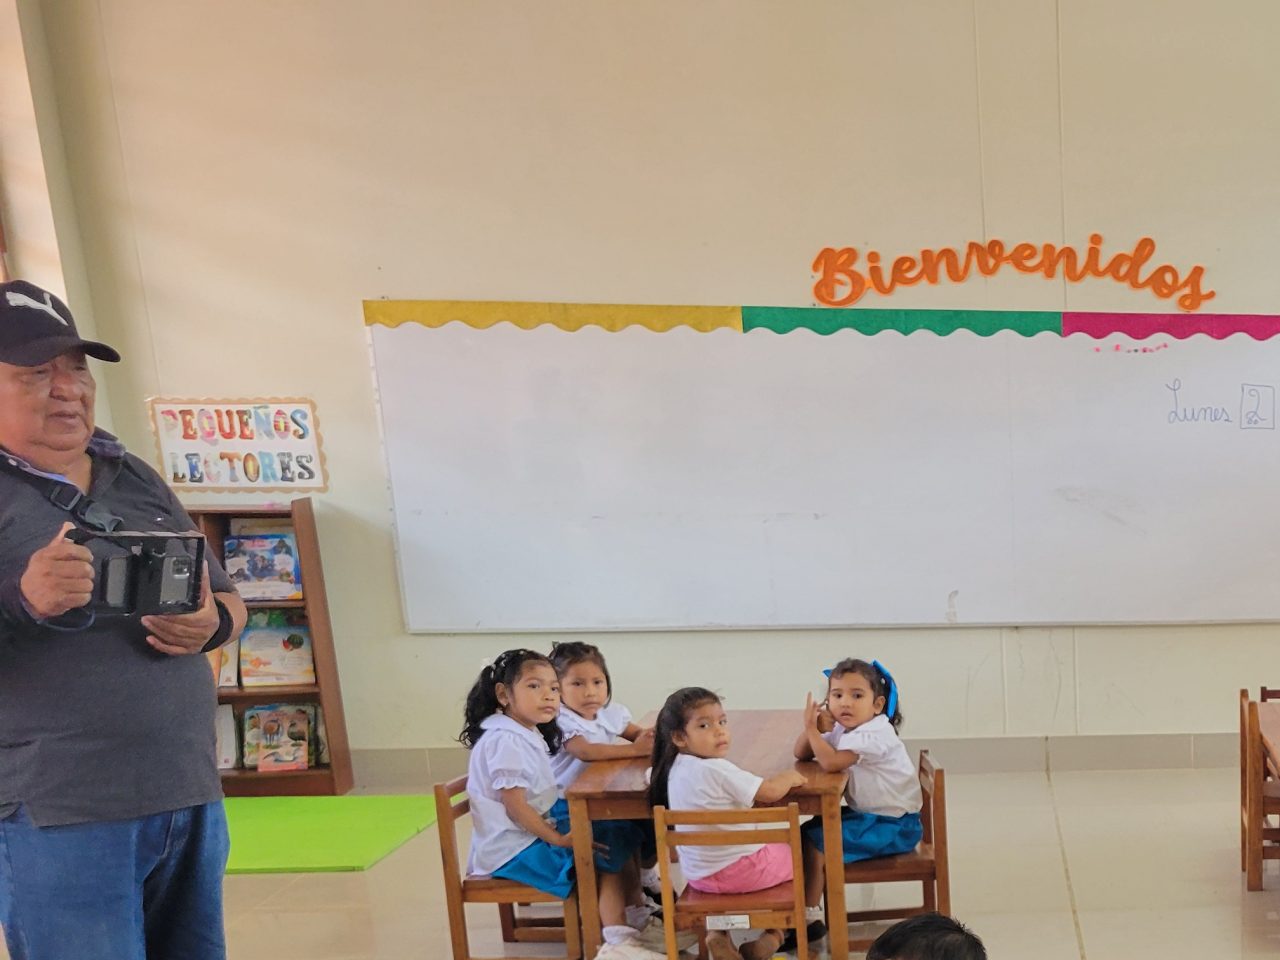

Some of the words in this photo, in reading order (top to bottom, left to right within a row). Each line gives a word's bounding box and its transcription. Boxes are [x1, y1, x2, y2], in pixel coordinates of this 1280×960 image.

[812, 233, 1216, 312] Bienvenidos
[1165, 378, 1233, 424] Lunes
[1245, 388, 1267, 425] 2
[161, 404, 310, 447] PEQUEÑOS
[169, 450, 315, 483] LECTORES
